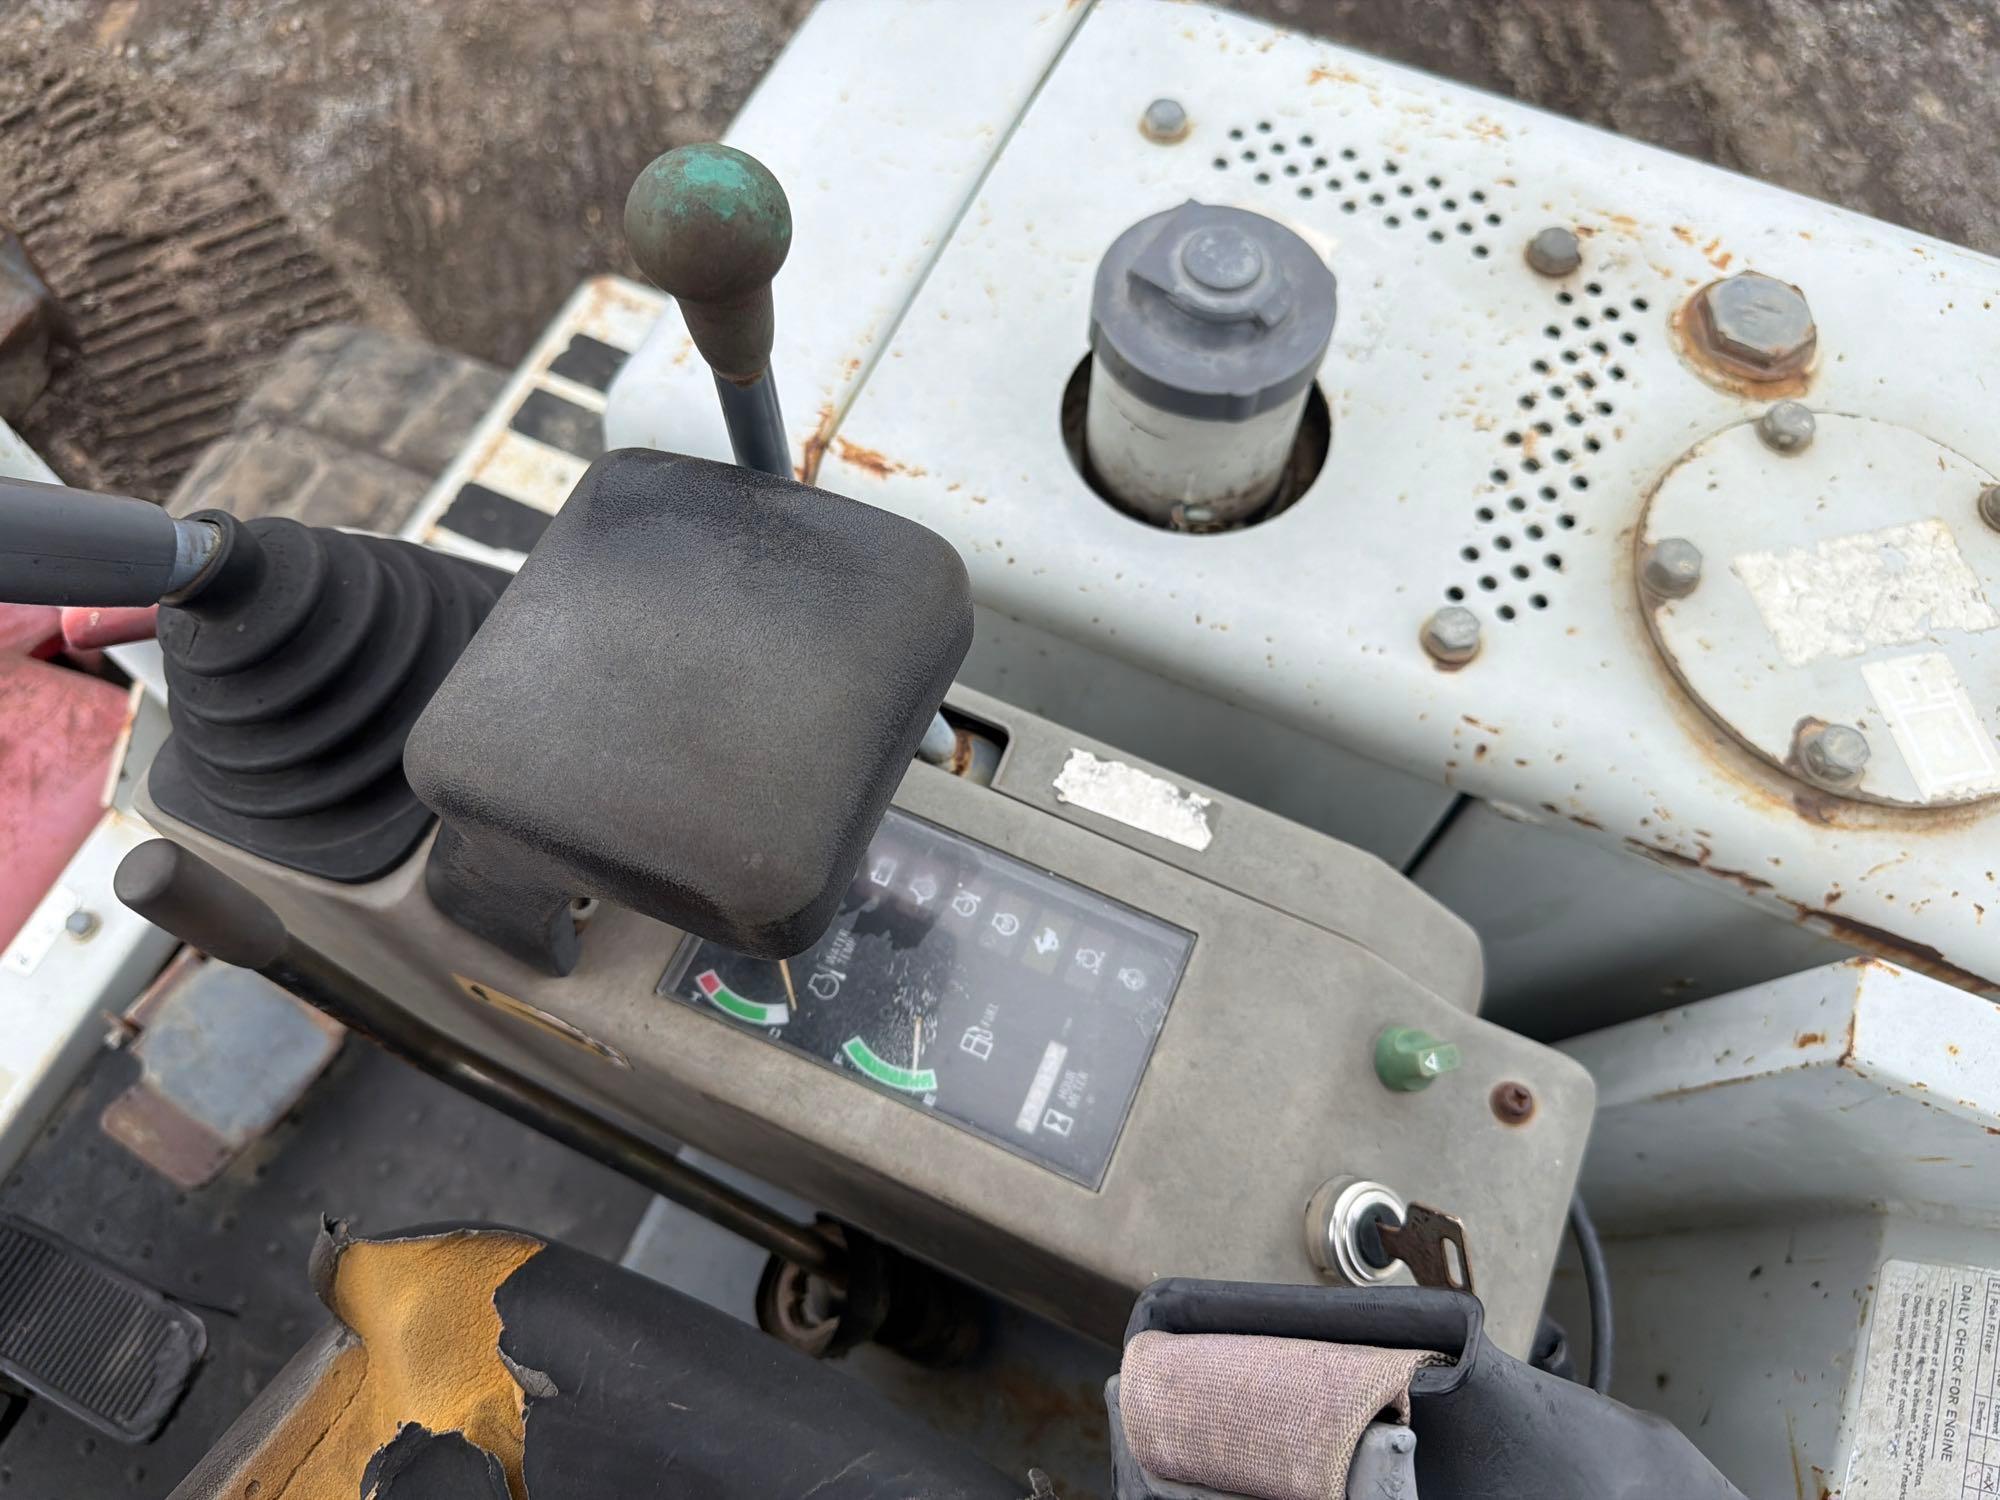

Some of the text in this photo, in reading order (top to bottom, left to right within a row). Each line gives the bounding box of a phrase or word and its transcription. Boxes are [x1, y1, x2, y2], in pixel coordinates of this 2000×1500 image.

[1989, 1298, 1998, 1320] Fuel
[1984, 1324, 1995, 1354] Filter
[1941, 1285, 1972, 1462] DAILY CHECK FOR ENGINE
